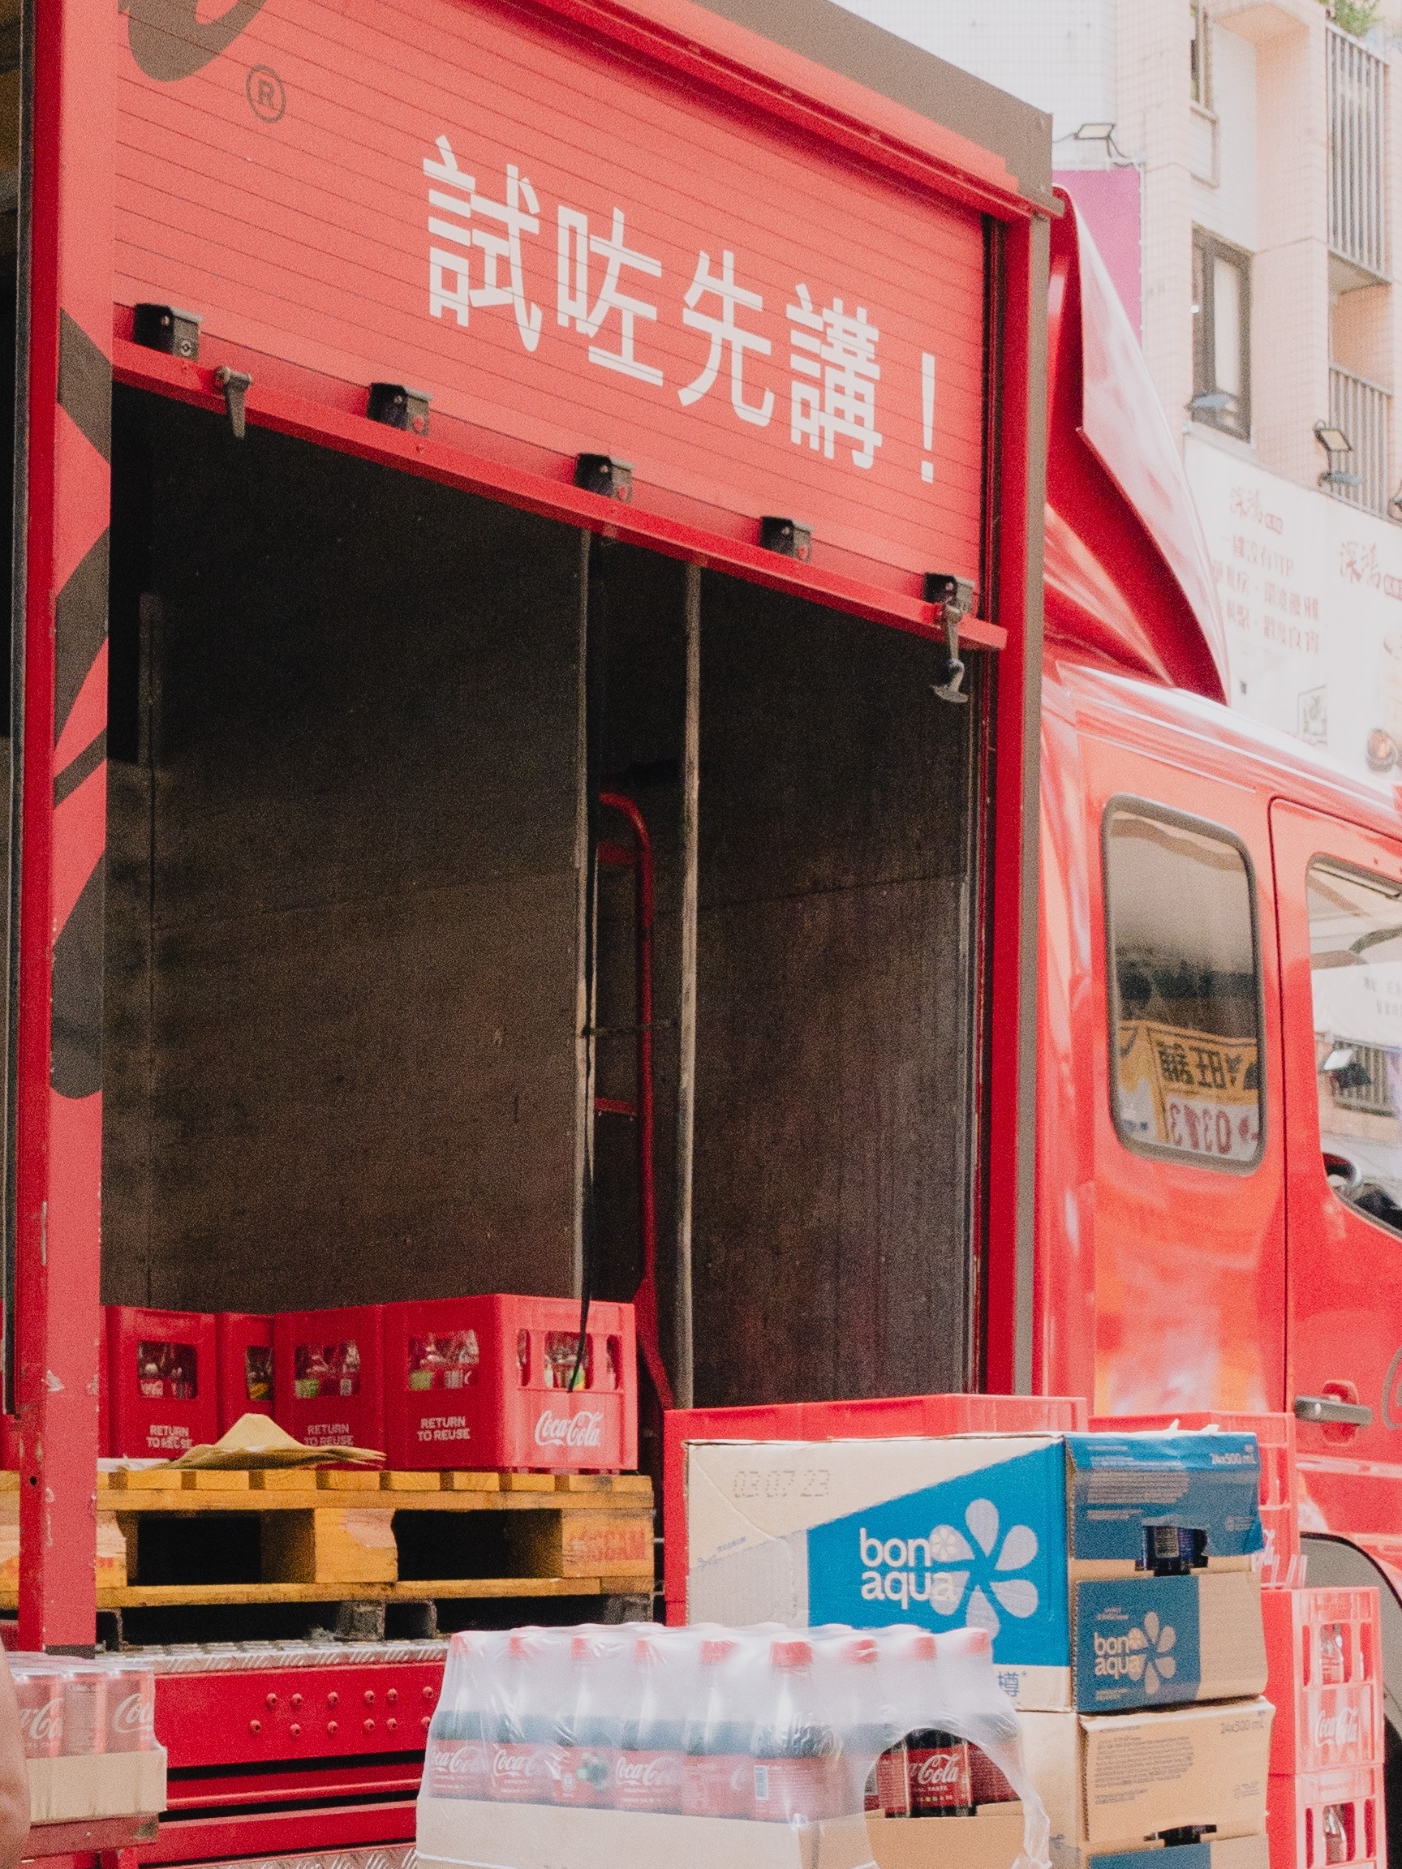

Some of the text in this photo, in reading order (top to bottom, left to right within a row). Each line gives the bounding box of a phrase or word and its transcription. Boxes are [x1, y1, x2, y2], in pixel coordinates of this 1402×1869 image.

[420, 1416, 466, 1429] RETURN
[534, 1410, 603, 1447] Coca-Cola
[149, 1425, 189, 1436] RETURN
[307, 1424, 349, 1435] RETURN
[417, 1429, 471, 1442] TO REUSE
[147, 1437, 159, 1448] TO
[304, 1437, 317, 1446] TO
[859, 1527, 932, 1568] bon
[860, 1571, 956, 1610] aqua
[1094, 1631, 1130, 1655] bon
[1094, 1656, 1141, 1679] aqua
